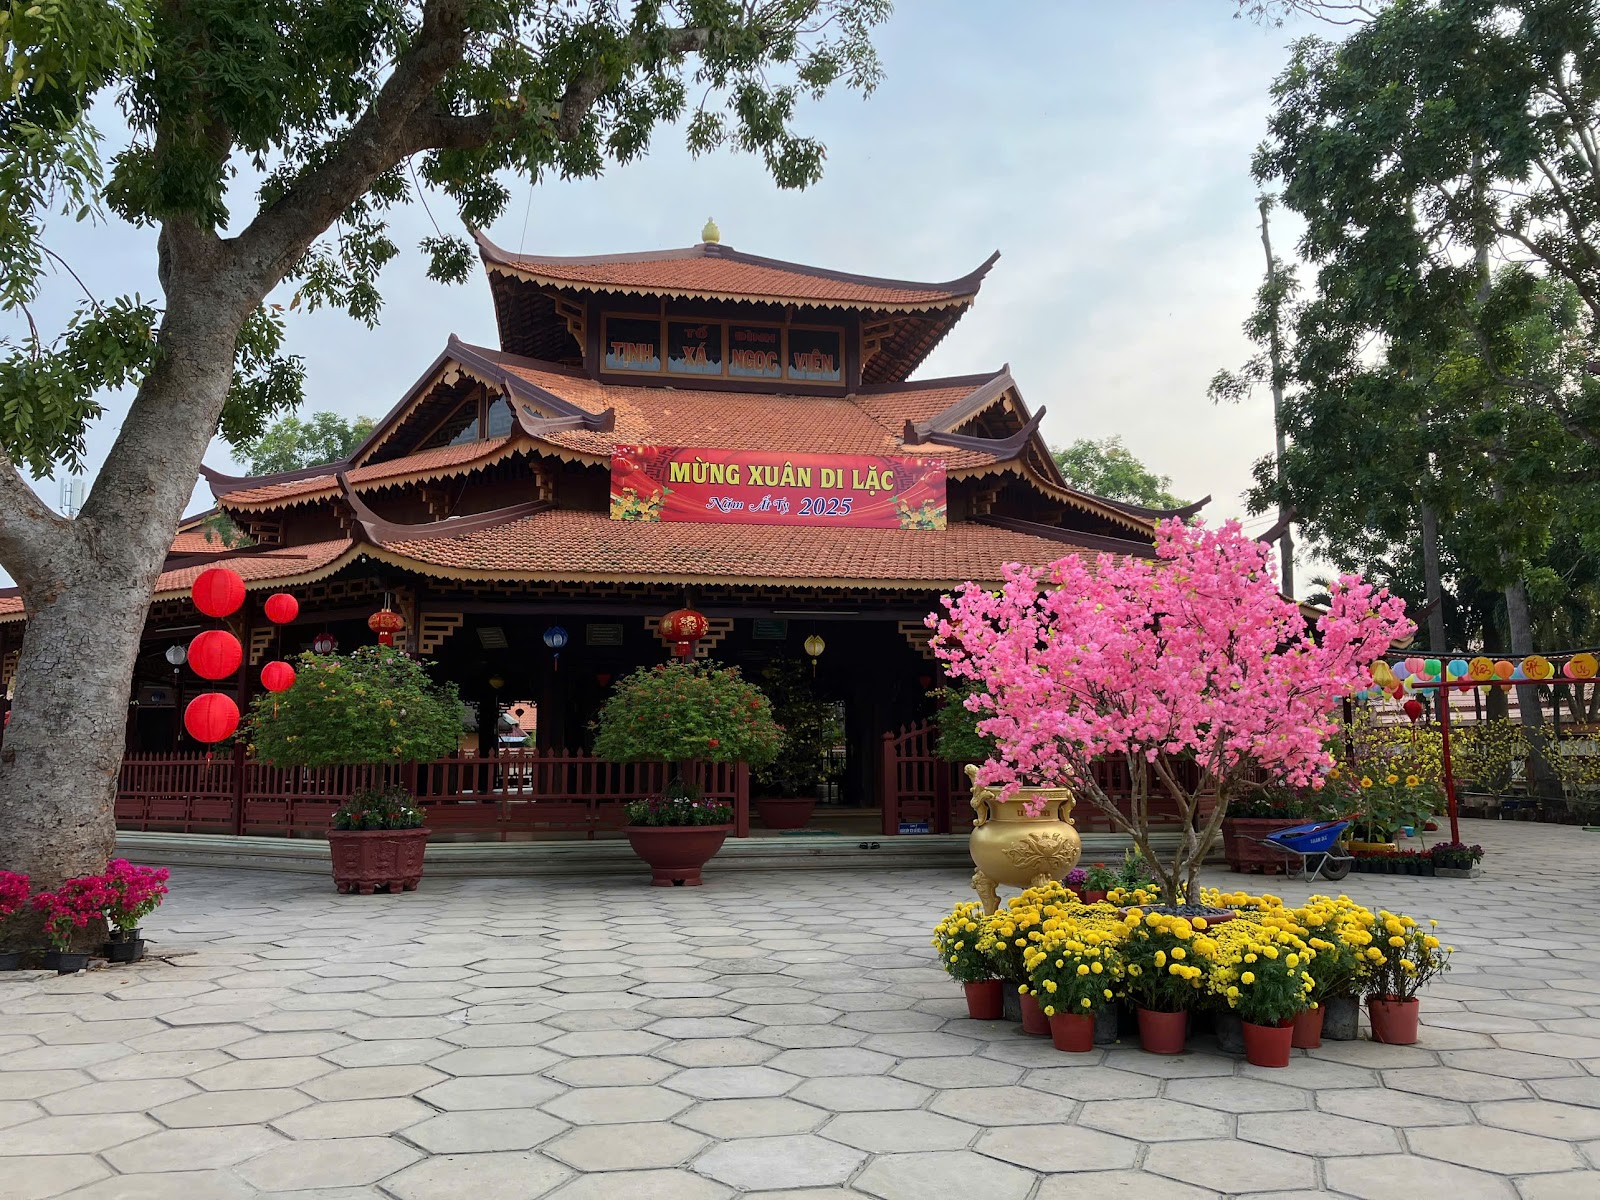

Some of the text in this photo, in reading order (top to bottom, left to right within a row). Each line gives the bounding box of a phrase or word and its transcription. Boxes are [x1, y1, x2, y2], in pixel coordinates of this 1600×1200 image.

[611, 341, 834, 374] TỊNH XÁ NGỌC VIÊN
[669, 456, 894, 496] MỪNG XUÂN DI LẶC
[706, 496, 744, 513] Năm
[797, 496, 854, 516] 2025
